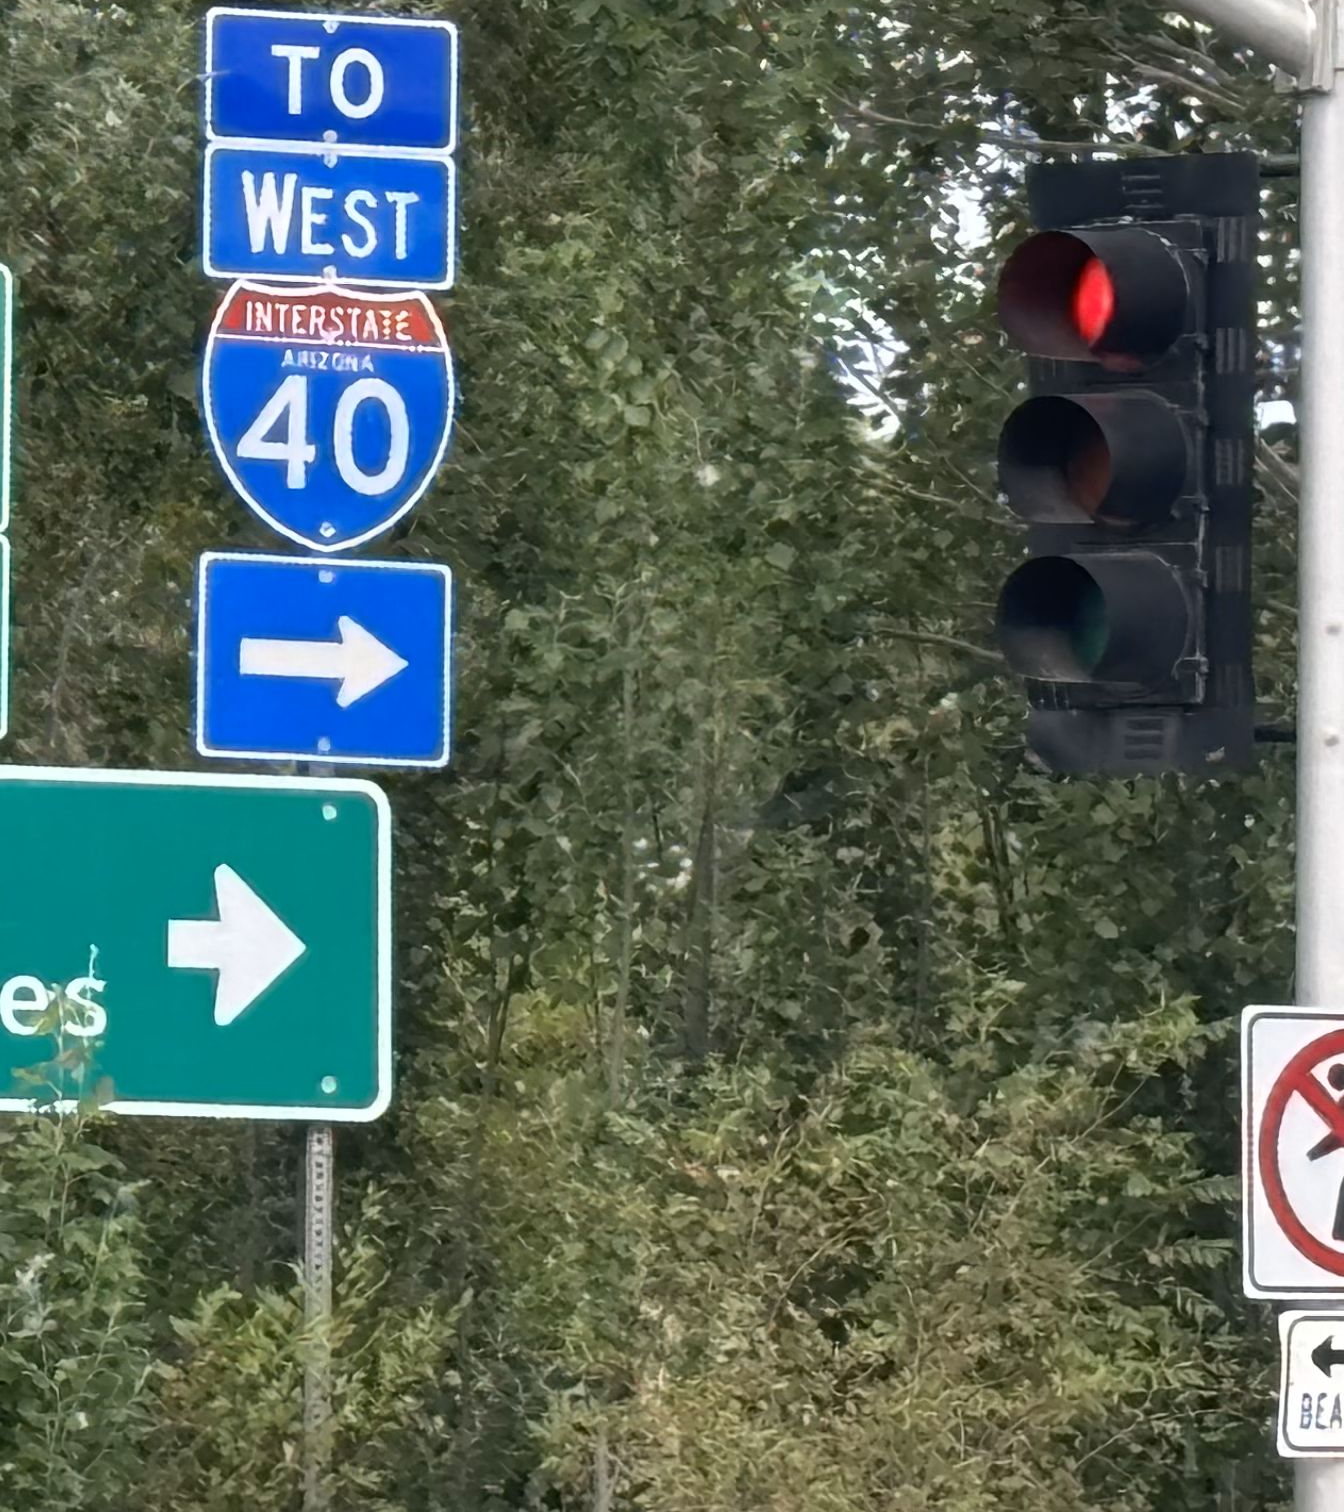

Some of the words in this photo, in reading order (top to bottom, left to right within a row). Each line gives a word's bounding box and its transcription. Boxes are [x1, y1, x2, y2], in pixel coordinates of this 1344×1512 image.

[271, 44, 384, 120] TO
[241, 170, 420, 260] WEST
[244, 300, 413, 342] INTERSTATE
[280, 351, 375, 373] ARIZONA
[236, 374, 409, 496] 40
